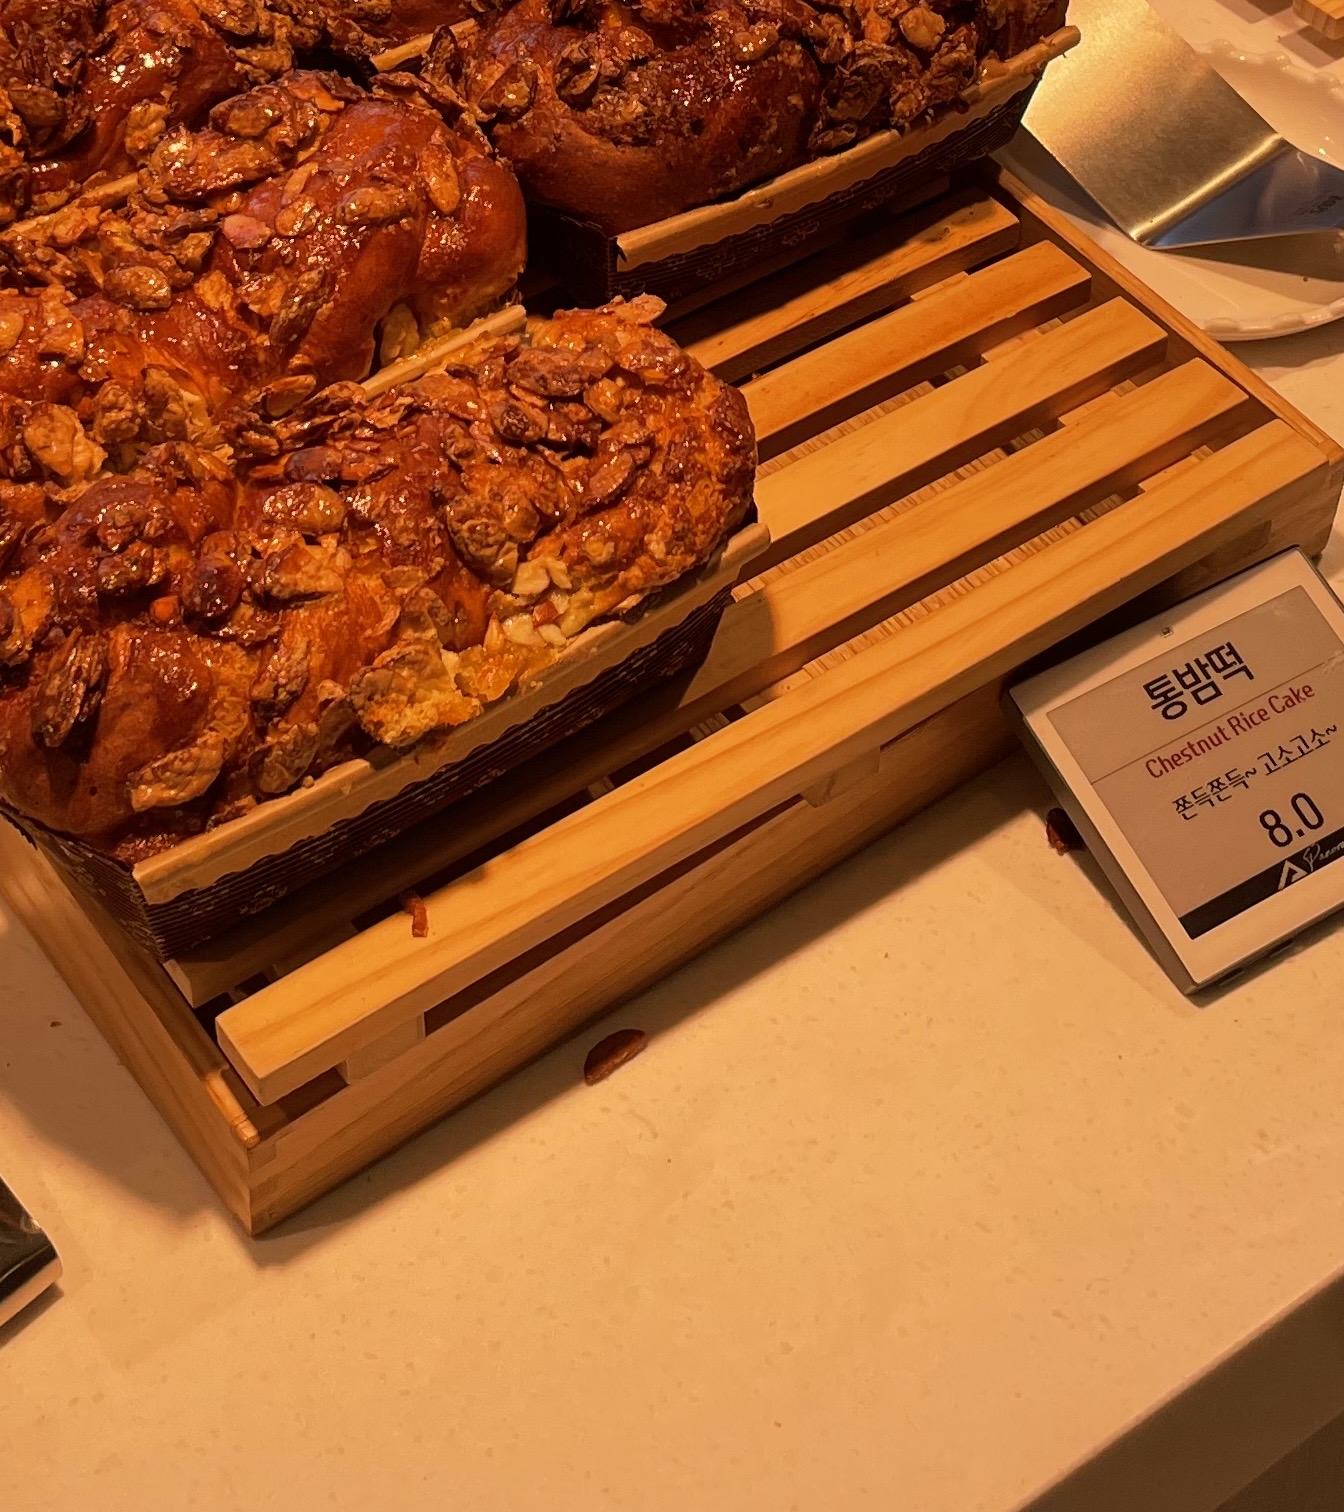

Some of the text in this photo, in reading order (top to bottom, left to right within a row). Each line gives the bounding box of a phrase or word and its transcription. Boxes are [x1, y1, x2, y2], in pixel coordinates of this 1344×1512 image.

[1142, 641, 1255, 721] 통밤떡
[1145, 684, 1316, 779] Chestnut Rice Cake
[1172, 724, 1338, 821] 쫀득쫀득~ 고소고소~
[1259, 792, 1325, 848] 8.0
